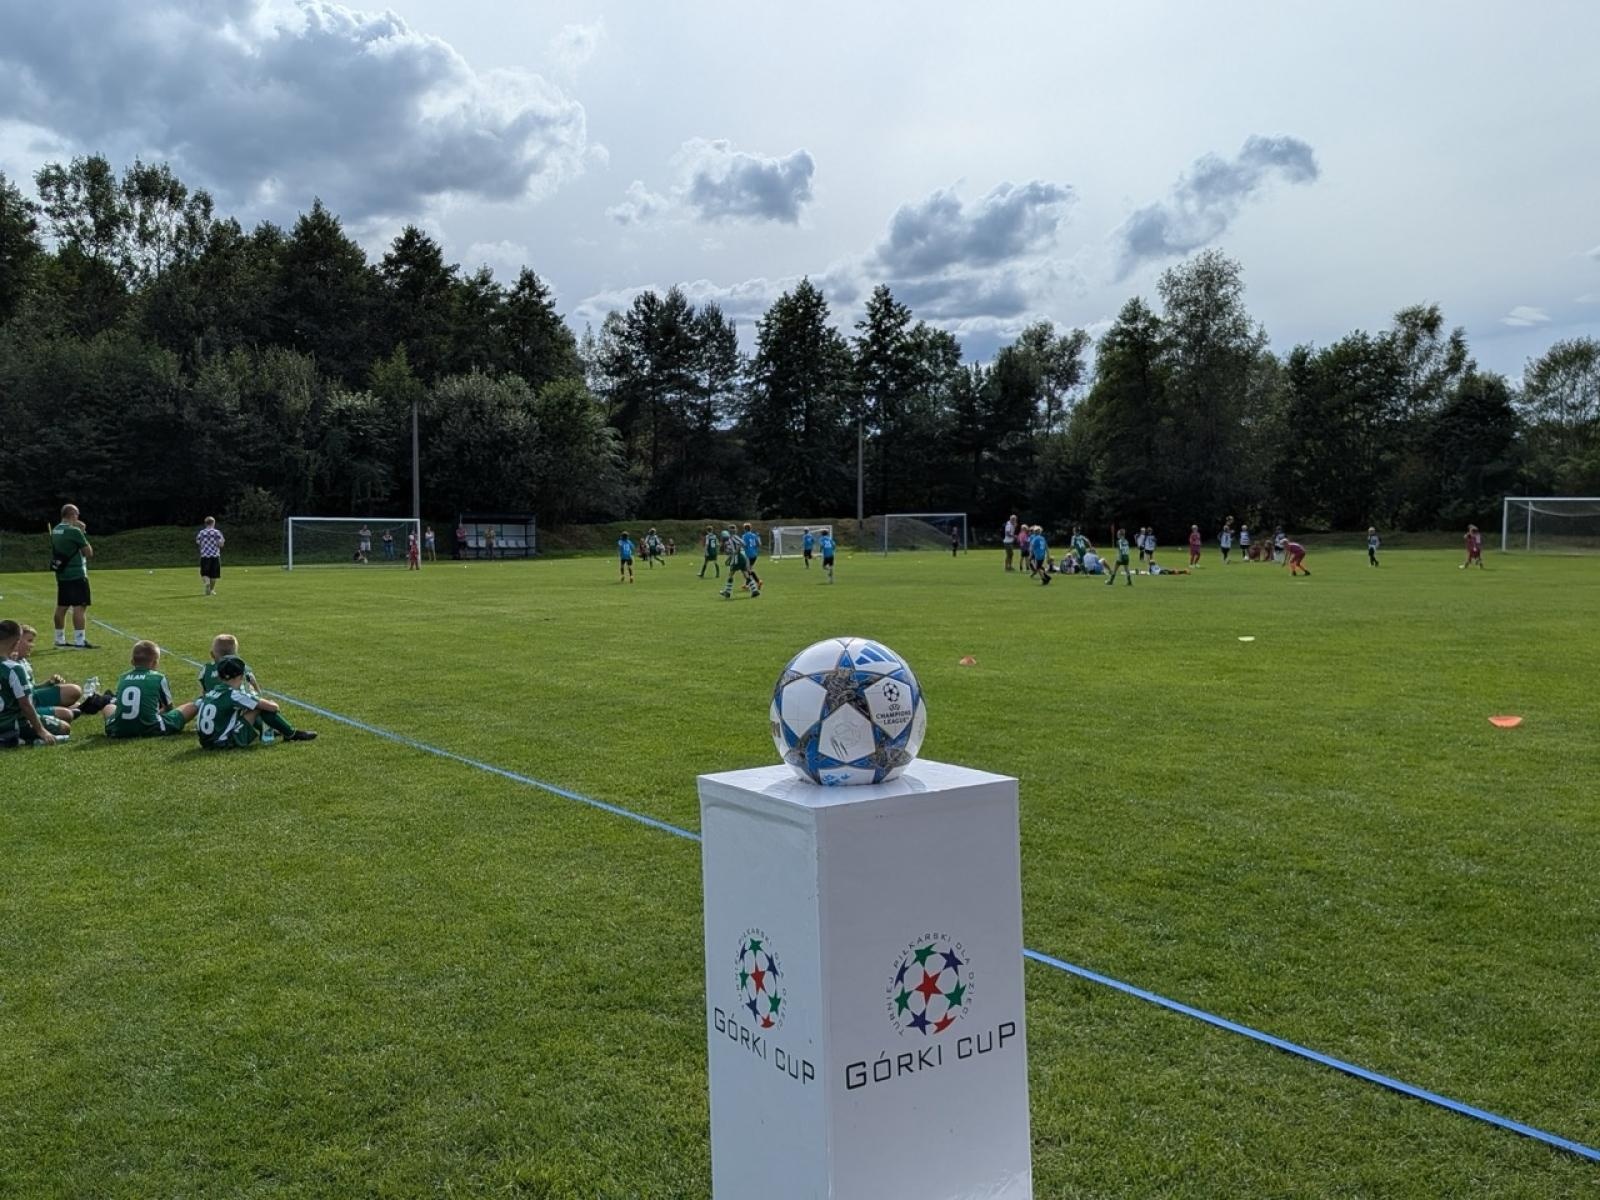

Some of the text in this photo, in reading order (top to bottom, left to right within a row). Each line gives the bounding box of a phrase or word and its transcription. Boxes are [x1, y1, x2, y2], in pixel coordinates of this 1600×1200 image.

[121, 686, 141, 720] 9
[875, 710, 912, 720] CHAMPIONS
[200, 704, 217, 735] 8
[955, 942, 971, 965] DLA
[714, 1006, 815, 1085] GÓRKI CUP
[845, 1021, 1017, 1090] GÓRKI CUP
